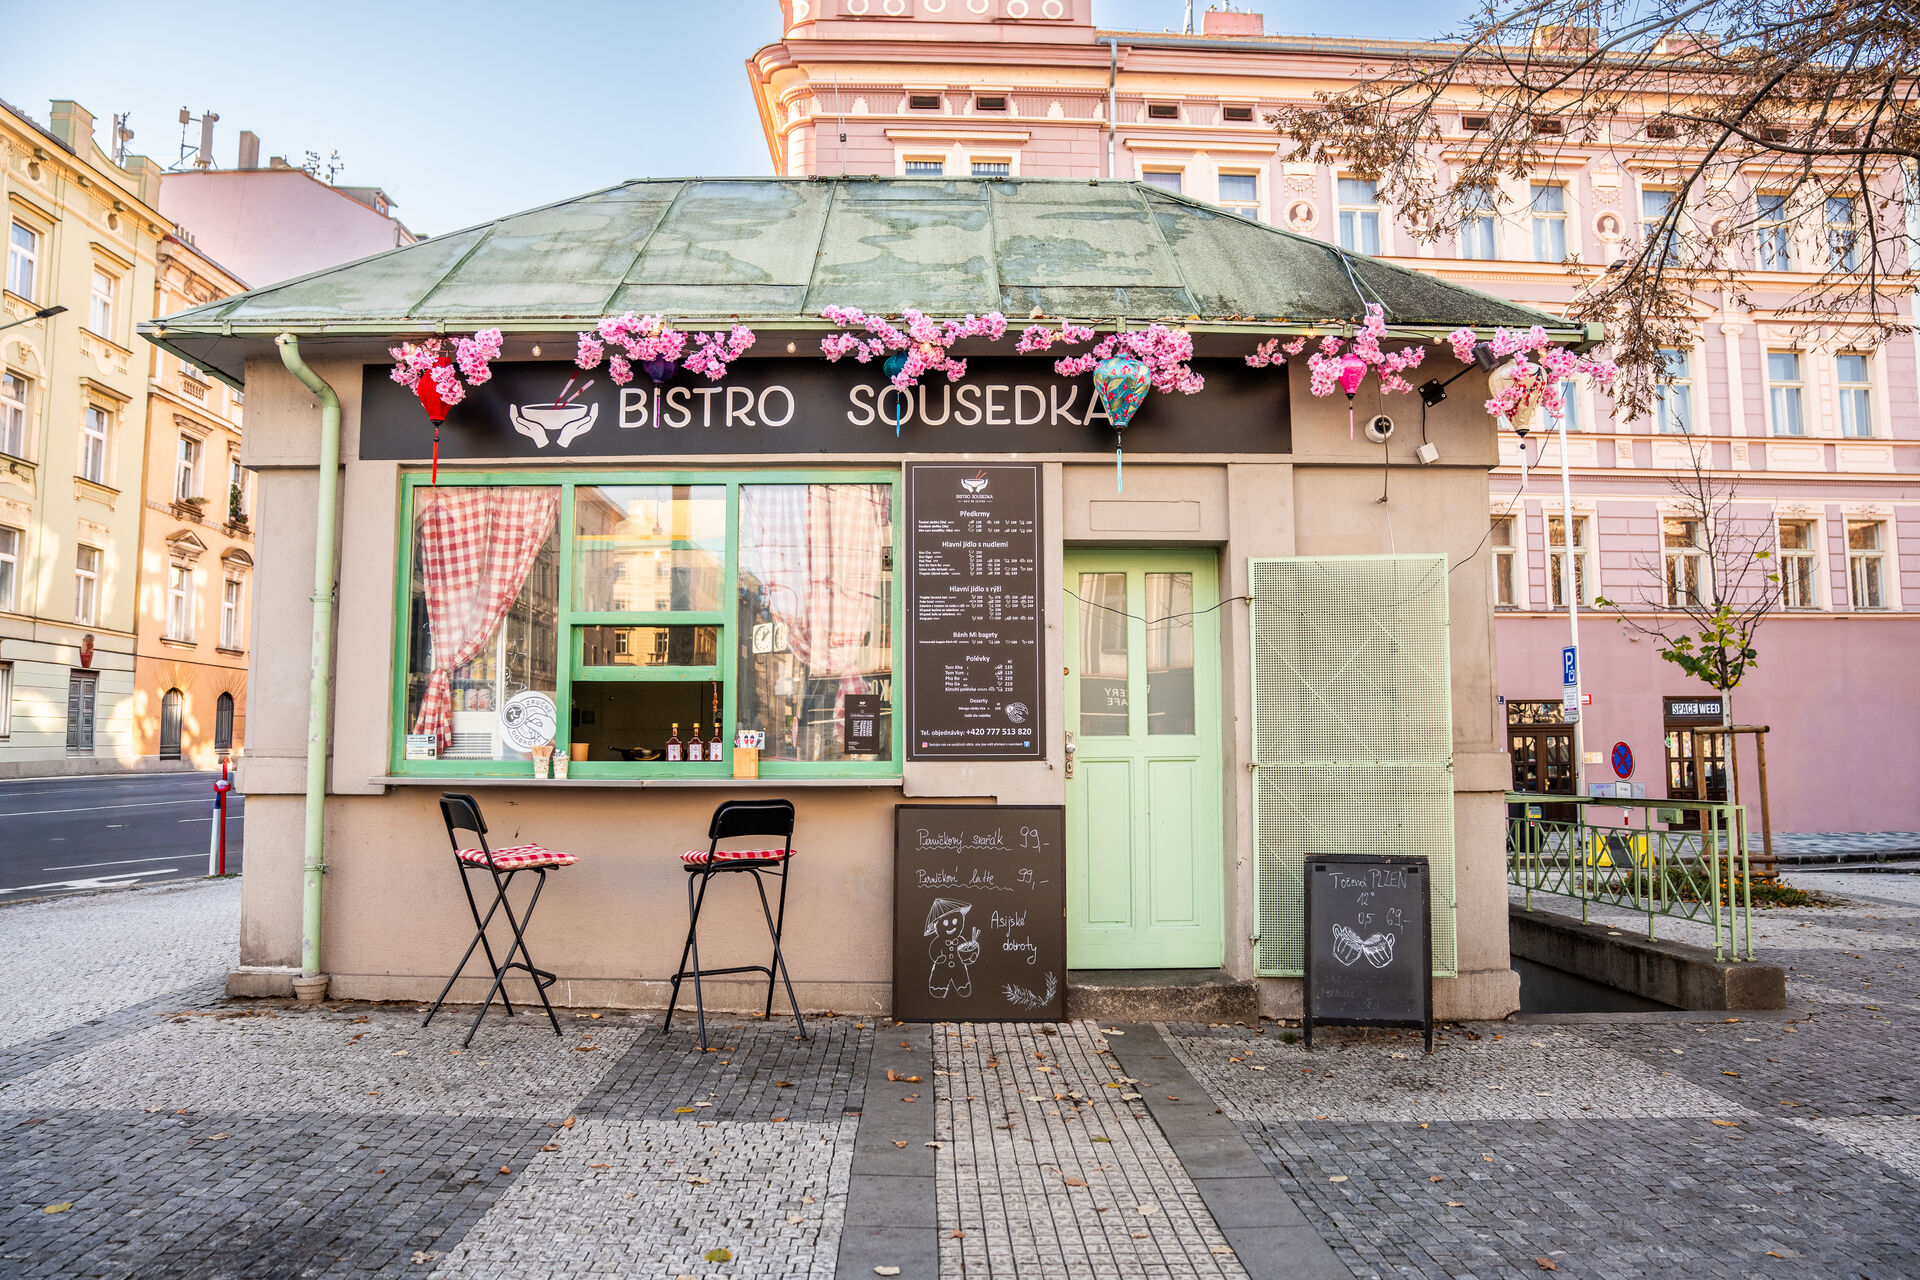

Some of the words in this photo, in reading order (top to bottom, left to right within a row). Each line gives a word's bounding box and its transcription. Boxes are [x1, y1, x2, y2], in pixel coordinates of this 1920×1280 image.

[619, 385, 795, 429] BISTRO
[847, 384, 1113, 427] SOUSEDKA
[959, 510, 991, 518] Předkrmy
[962, 541, 977, 549] jídlo
[970, 585, 985, 593] jídlo
[966, 655, 990, 663] Polévky
[1565, 651, 1573, 674] P
[1672, 704, 1697, 714] SPACE
[1699, 703, 1721, 714] WEED
[931, 729, 965, 737] objednávky:
[966, 728, 985, 736] +420
[986, 728, 1000, 736] 777
[1002, 728, 1016, 736] 513
[1017, 728, 1032, 736] 820
[968, 868, 995, 885] latte
[1368, 865, 1407, 889] PLZEŇ
